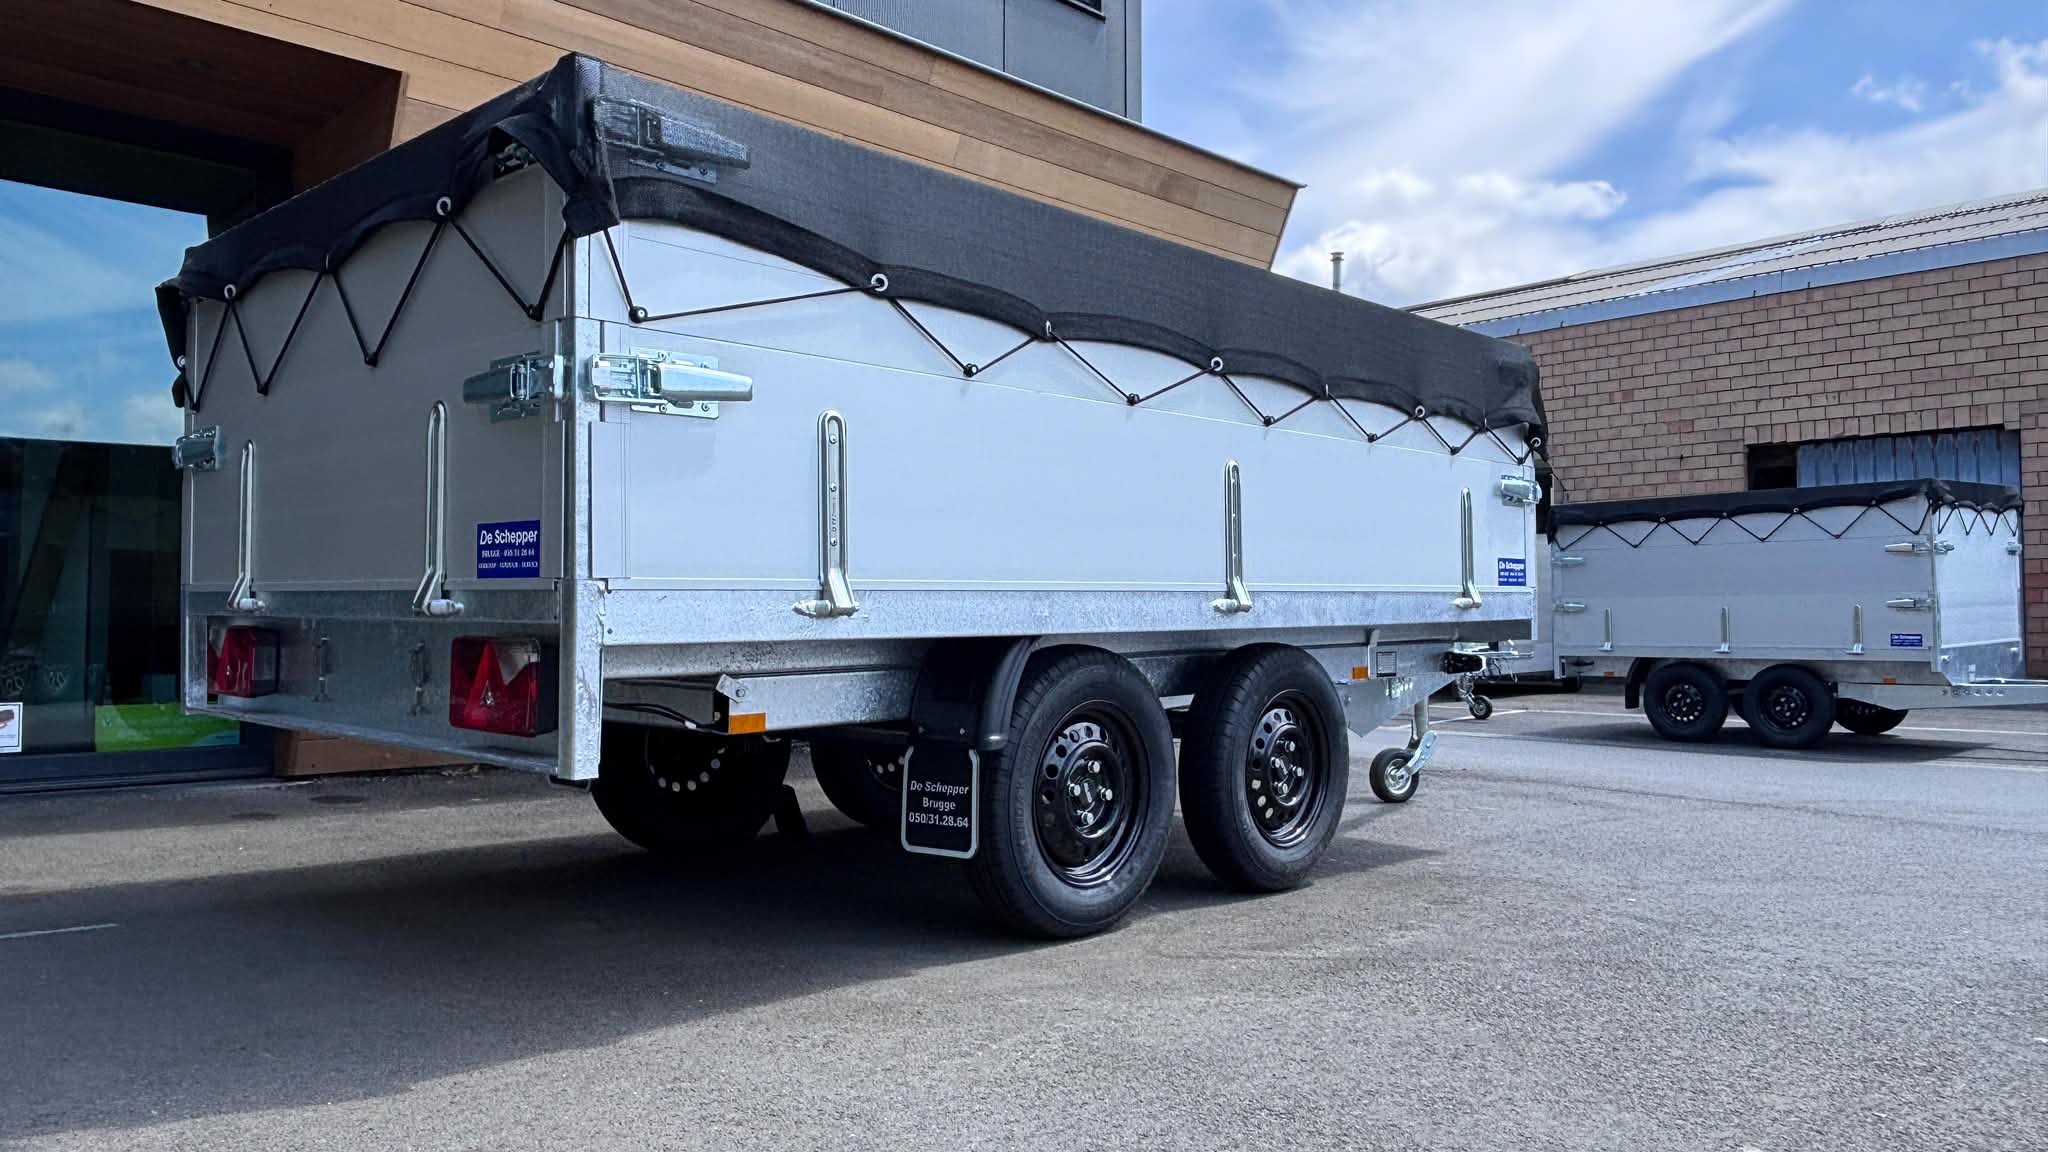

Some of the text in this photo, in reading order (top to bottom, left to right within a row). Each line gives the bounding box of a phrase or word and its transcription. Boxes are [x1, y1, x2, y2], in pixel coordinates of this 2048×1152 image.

[480, 529, 538, 546] De Schepper
[910, 781, 969, 796] De Schepper
[922, 797, 957, 812] Brugge
[908, 812, 969, 828] 050/31.28.64
